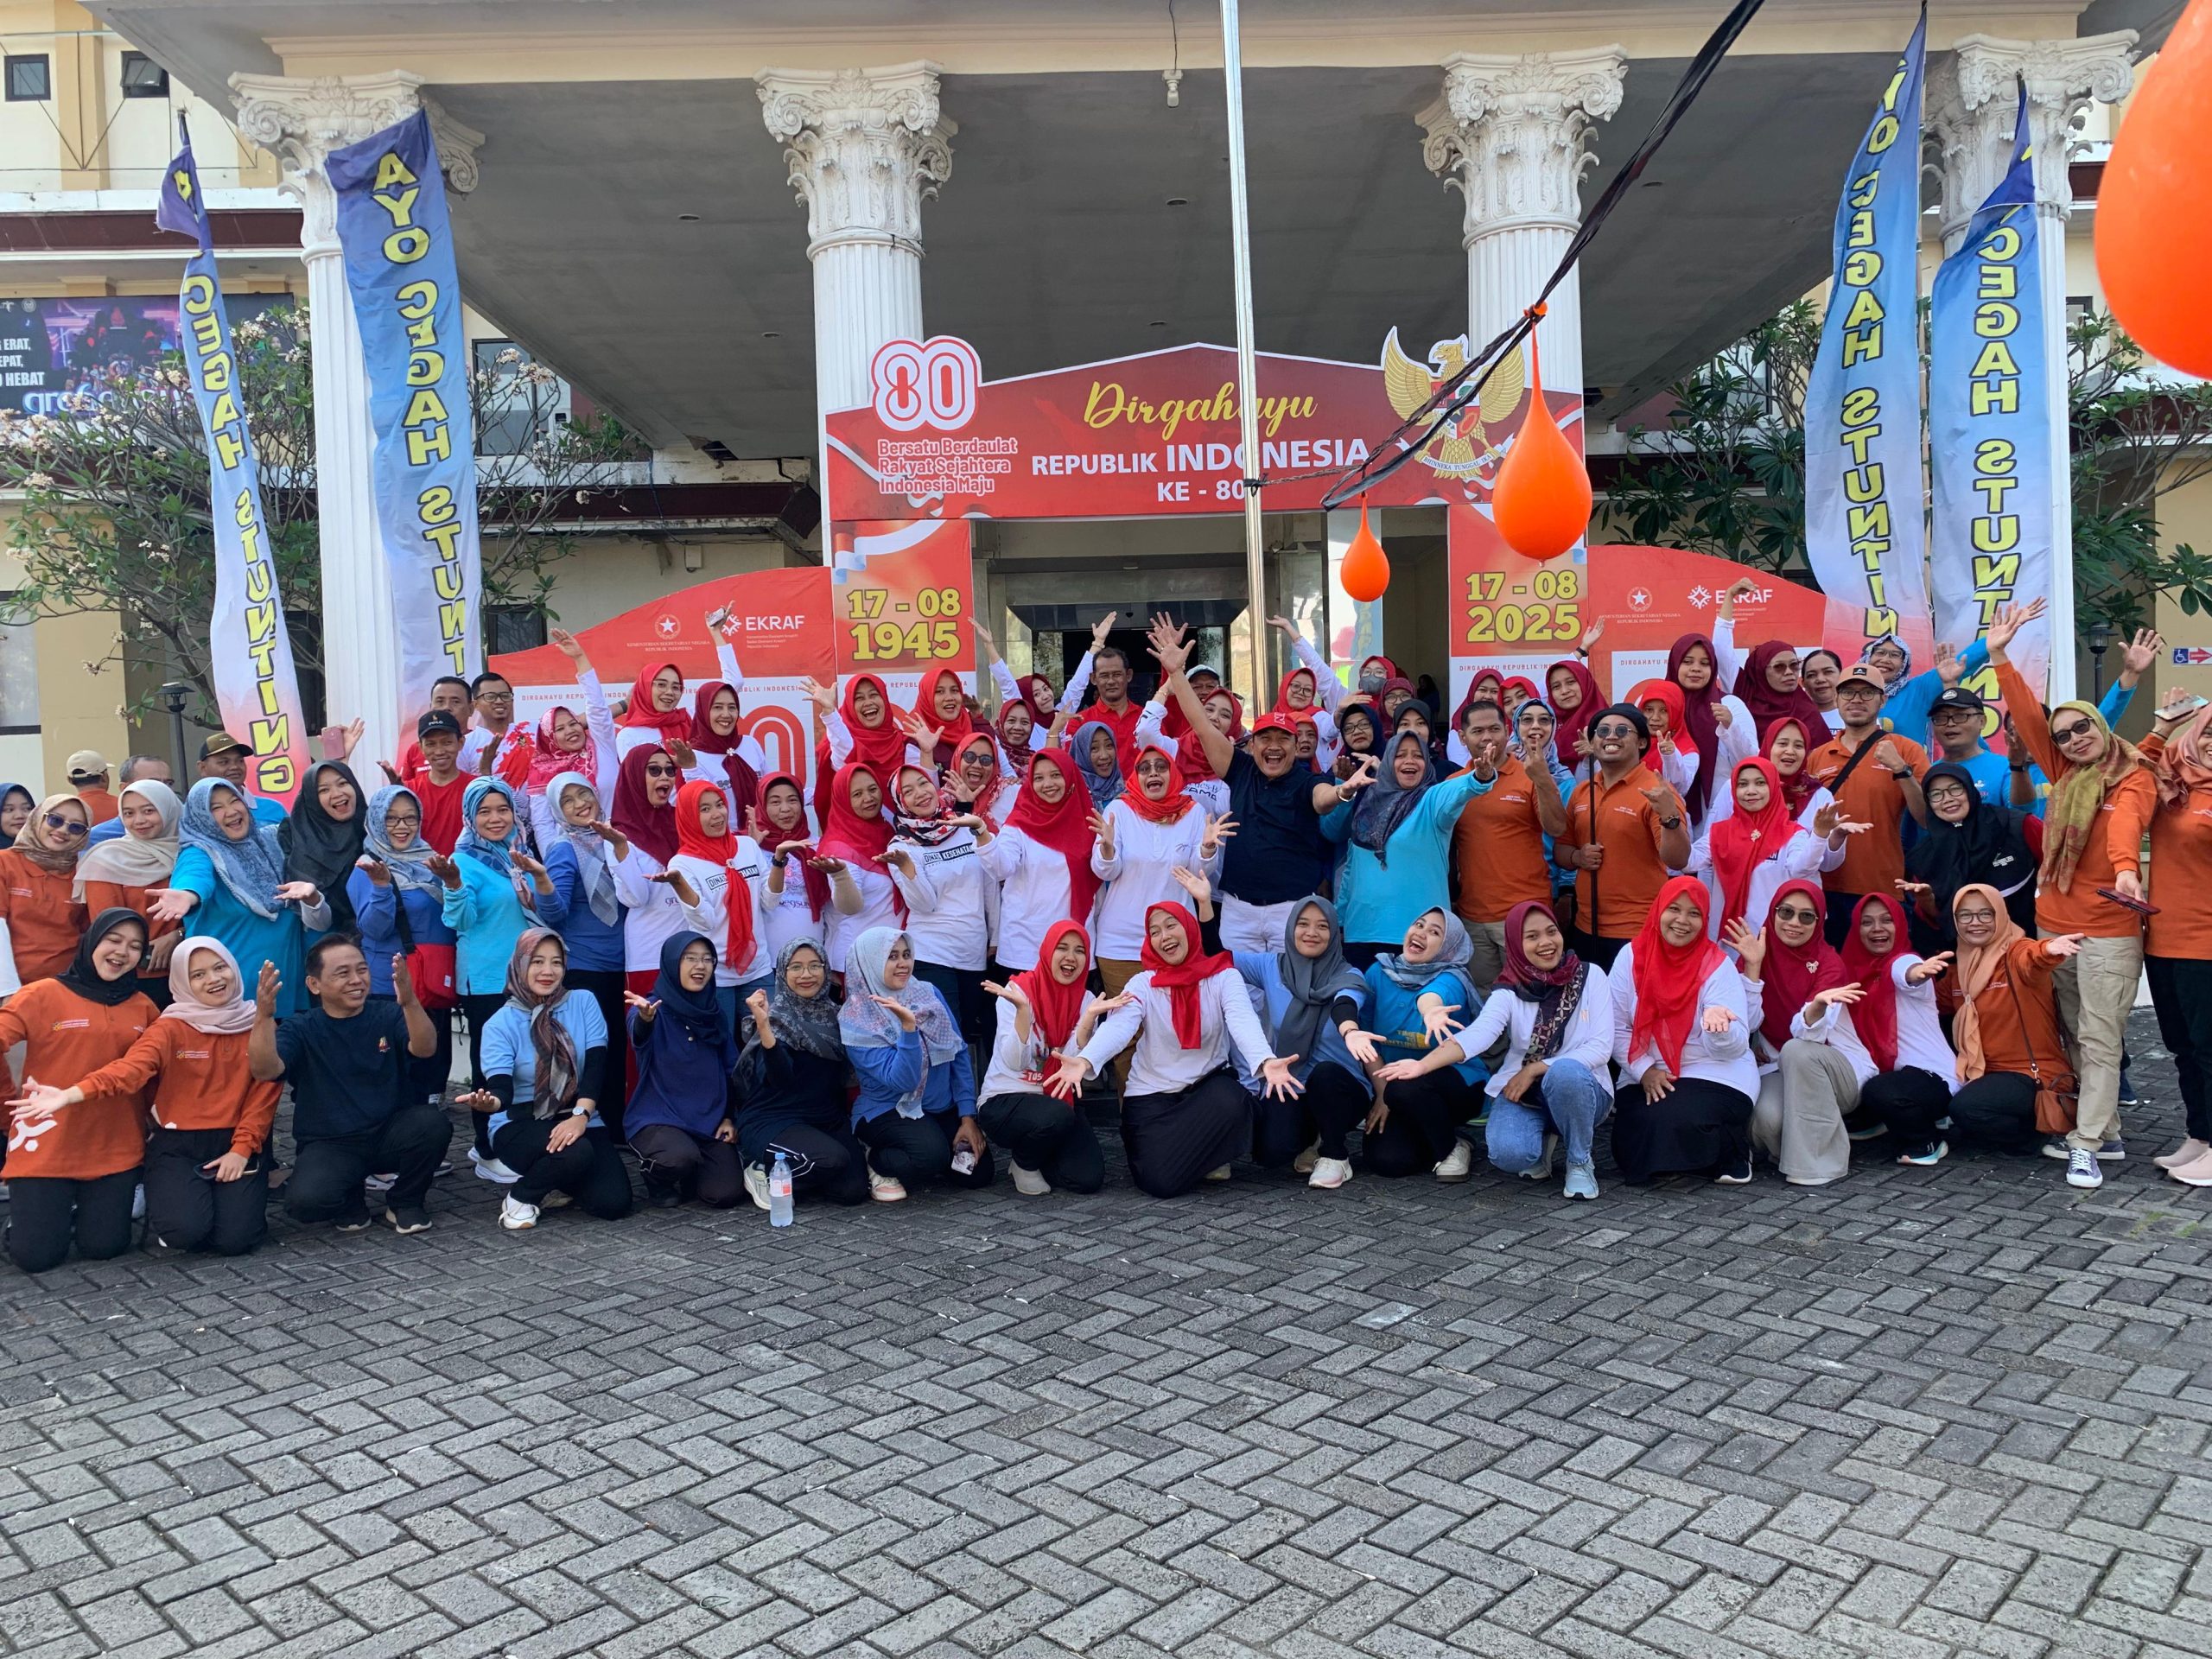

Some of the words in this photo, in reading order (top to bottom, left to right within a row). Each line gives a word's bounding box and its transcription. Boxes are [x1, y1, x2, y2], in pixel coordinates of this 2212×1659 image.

[3, 337, 31, 351] ERAT,
[5, 372, 44, 386] HEBAT
[871, 338, 978, 432] 80
[1084, 381, 1319, 442] Dirgahyu
[878, 438, 939, 456] Bersatu
[941, 436, 1018, 455] Berdaulat
[879, 458, 936, 478] Rakyat
[936, 455, 1011, 476] Sejahtera
[1032, 452, 1158, 475] REPUBLIK
[1423, 456, 1452, 471] BHINNEKA
[1454, 461, 1481, 471] TUNGGAL
[1481, 454, 1493, 465] IKA
[880, 478, 956, 495] Indonesia
[957, 475, 995, 497] Maju
[1157, 481, 1190, 502] KE
[1216, 480, 1245, 501] 80
[1465, 571, 1506, 601] 17
[1534, 569, 1579, 601] 08
[847, 588, 888, 620] 17
[917, 587, 962, 618] 08
[746, 615, 805, 631] EKRAF
[1466, 603, 1581, 643] 2025
[849, 621, 961, 661] 1945
